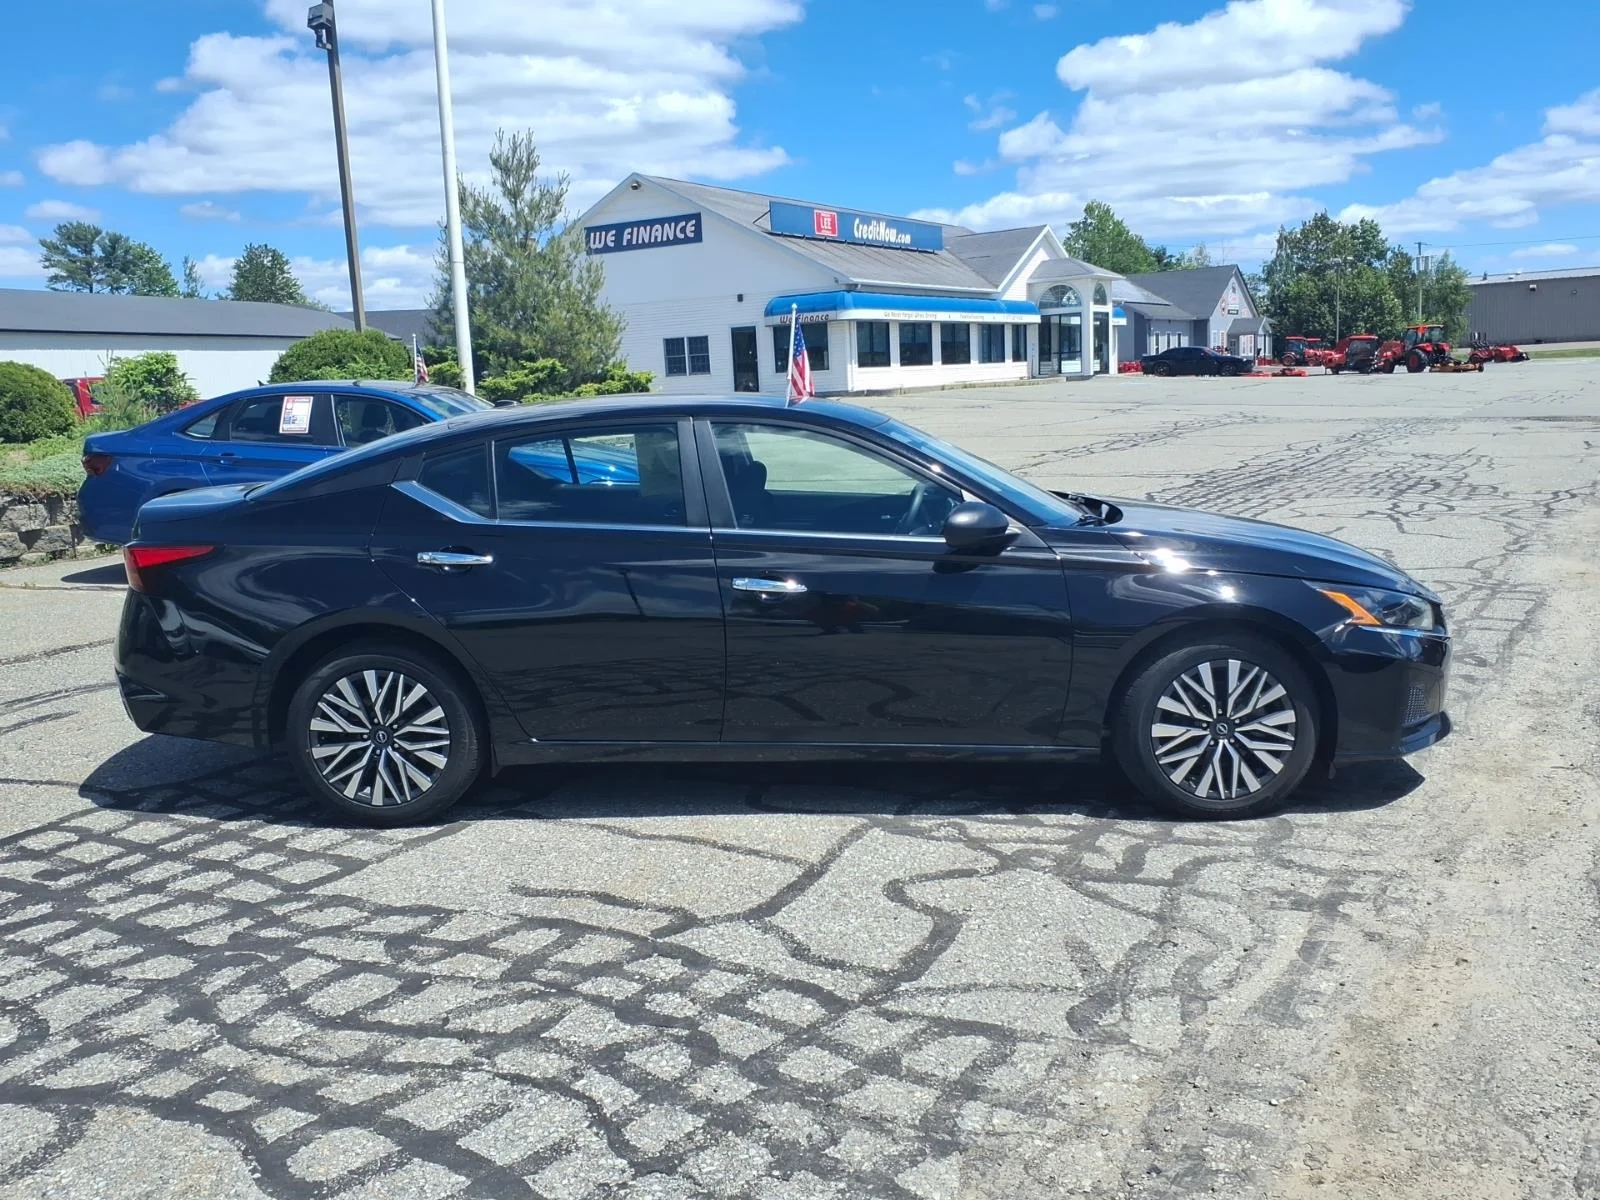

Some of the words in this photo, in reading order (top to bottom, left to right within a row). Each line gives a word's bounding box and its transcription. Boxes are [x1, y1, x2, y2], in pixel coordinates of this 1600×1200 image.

[590, 230, 616, 249] WE
[622, 220, 696, 246] FINANCE
[820, 216, 832, 230] LEE
[854, 218, 911, 244] CreditNow.com
